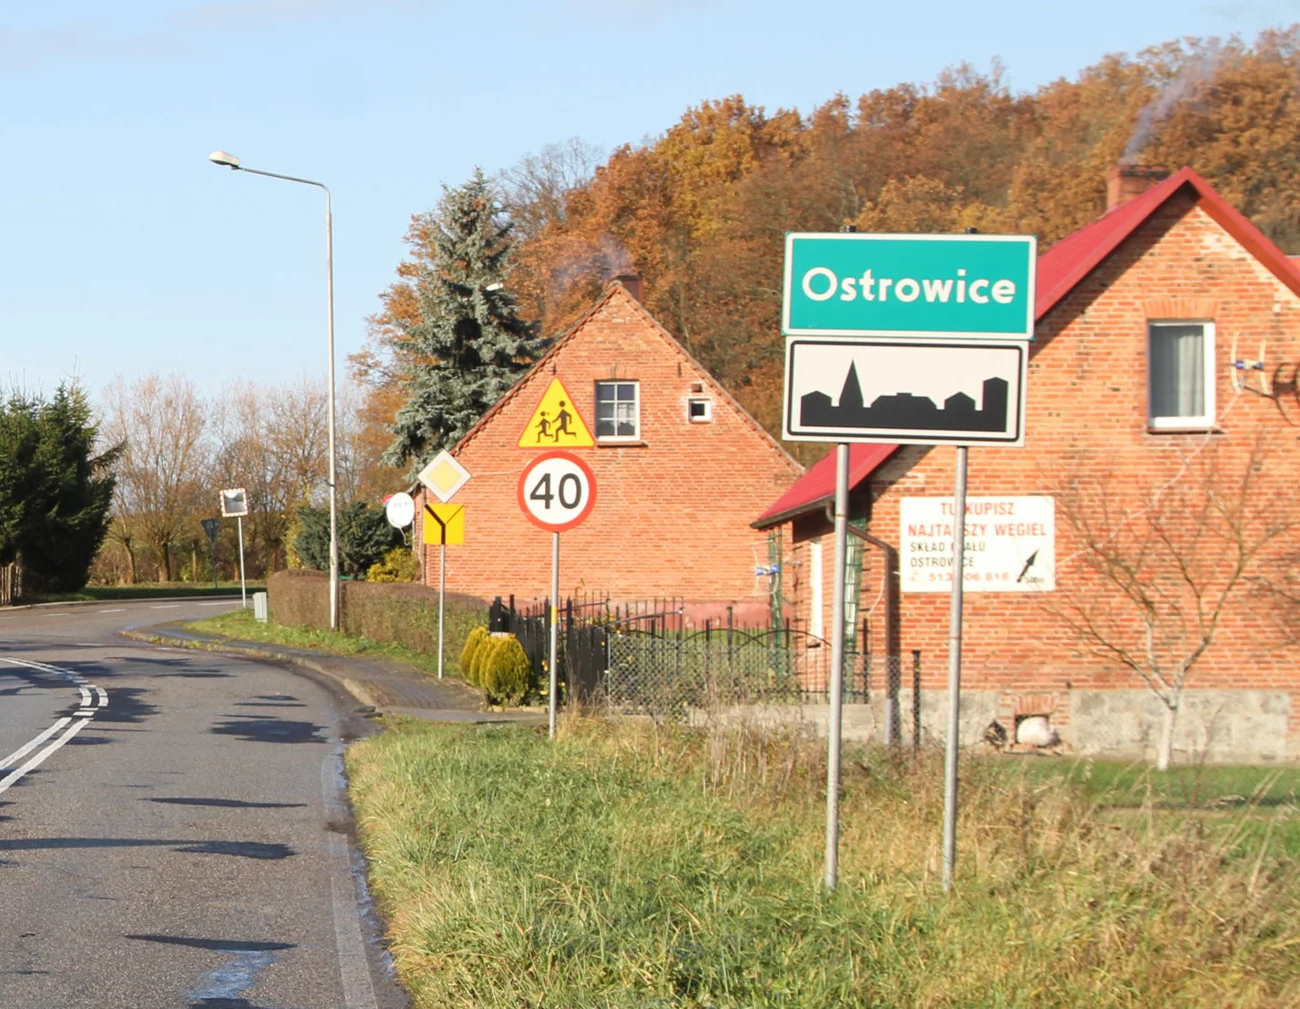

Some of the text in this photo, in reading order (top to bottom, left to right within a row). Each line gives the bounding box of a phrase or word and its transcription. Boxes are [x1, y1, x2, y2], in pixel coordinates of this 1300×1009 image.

[802, 266, 1016, 304] Ostrowice
[530, 473, 582, 510] 40
[964, 502, 1015, 516] KUPISZ
[908, 523, 988, 537] NAJTASZY
[910, 542, 945, 553] SKŁAD
[910, 557, 975, 568] OSTROWCE
